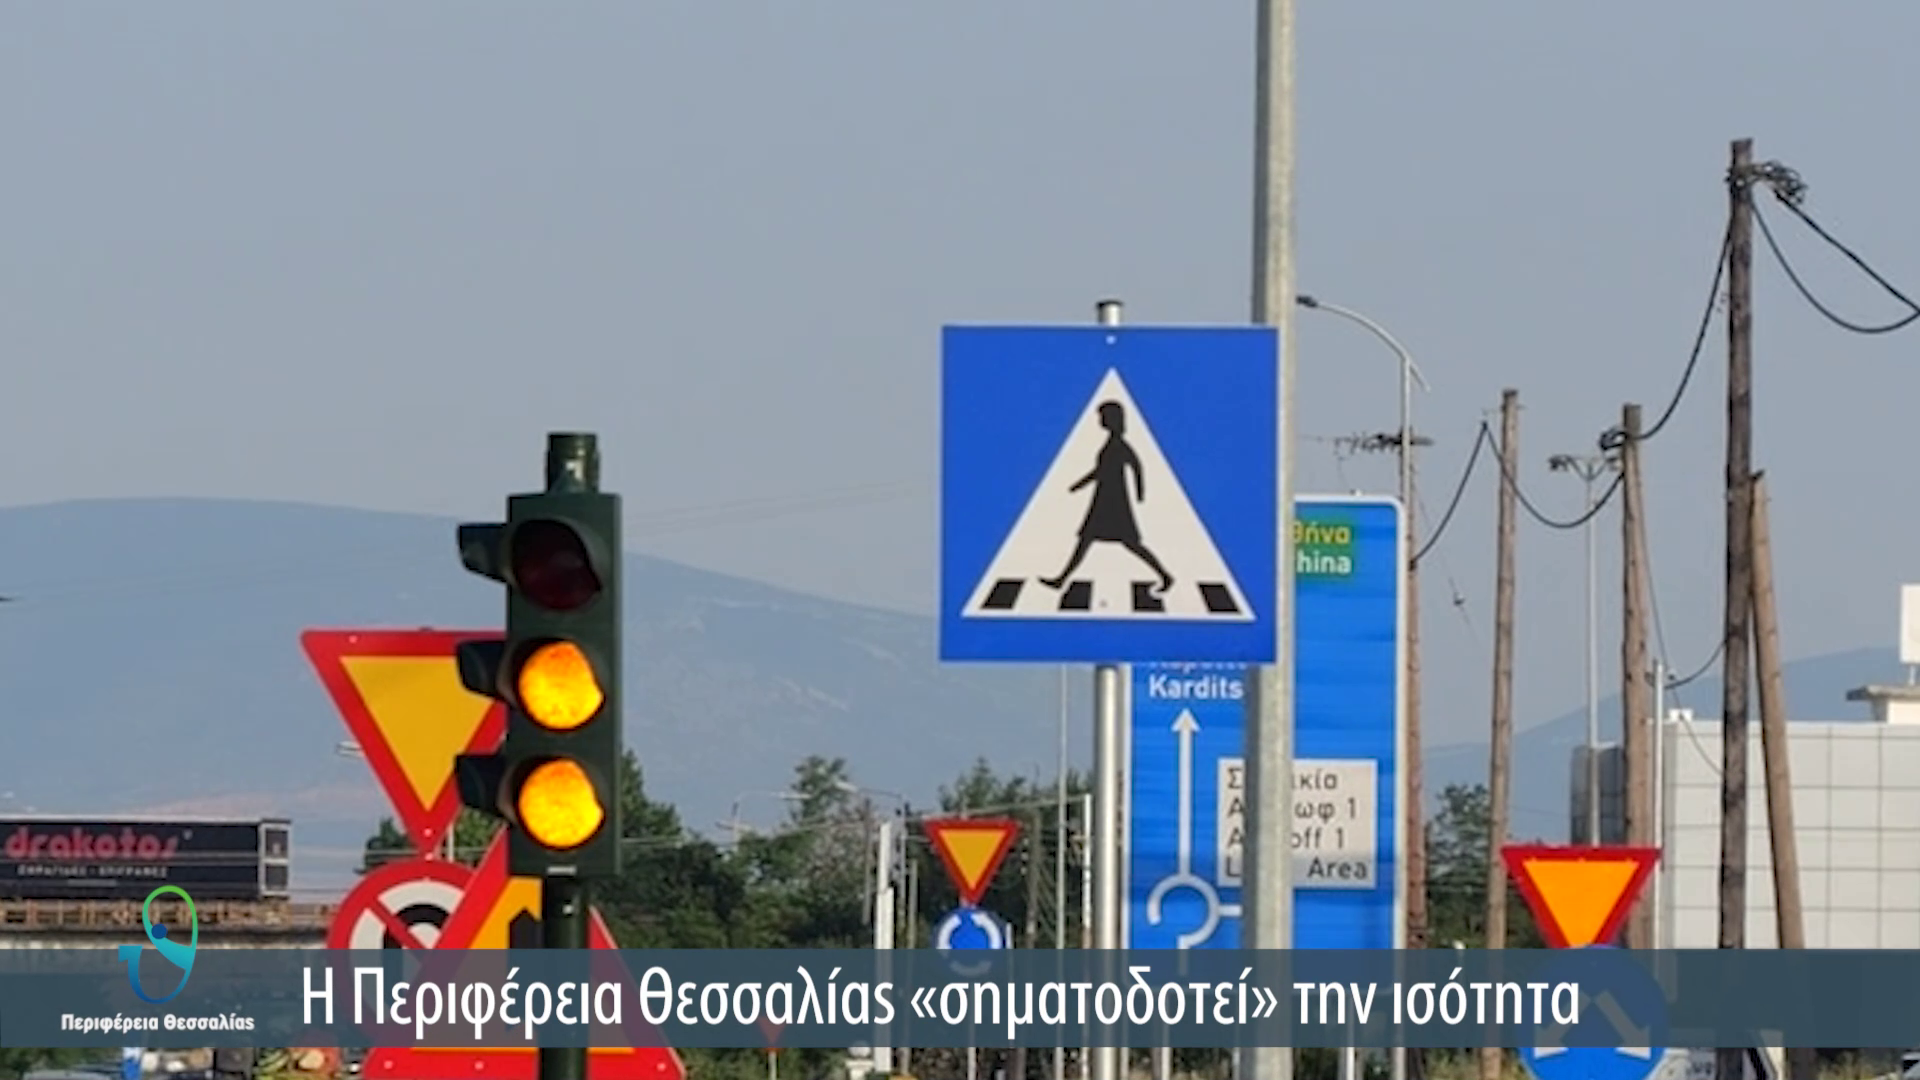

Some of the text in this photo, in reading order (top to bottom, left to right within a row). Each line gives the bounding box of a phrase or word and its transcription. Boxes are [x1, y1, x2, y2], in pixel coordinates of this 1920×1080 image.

[1292, 520, 1350, 544] θήνα
[1297, 549, 1352, 573] hina
[1149, 673, 1244, 699] Kardits
[1307, 857, 1367, 879] Area
